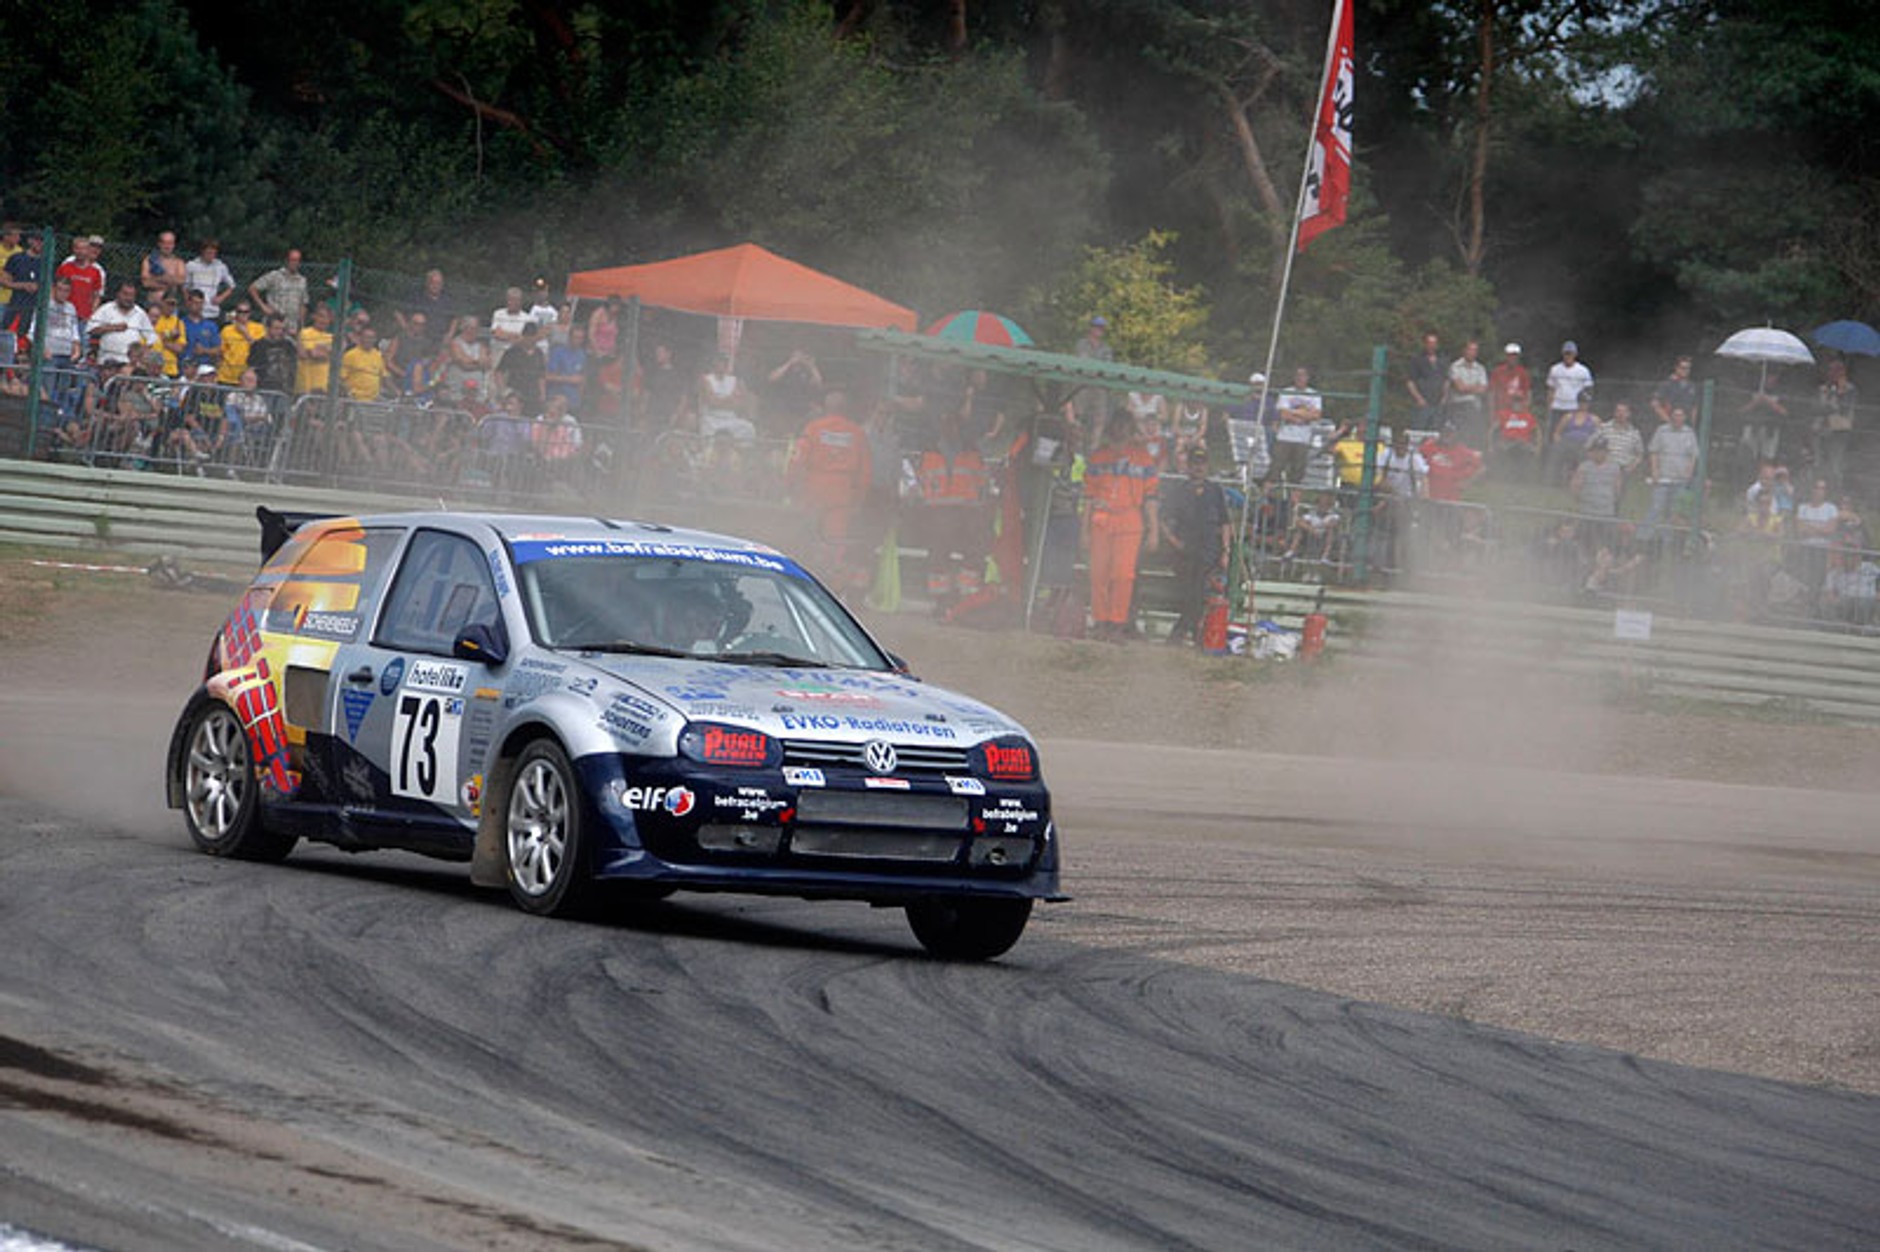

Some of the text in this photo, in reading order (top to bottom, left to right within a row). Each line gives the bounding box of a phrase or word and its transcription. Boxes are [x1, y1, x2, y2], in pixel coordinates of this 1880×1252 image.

[545, 542, 784, 571] www.befrabelgium.be
[780, 713, 956, 739] EVKO-Radiatoren
[400, 695, 440, 797] 73
[621, 786, 666, 811] elf
[982, 808, 1038, 822] befrabelgium
